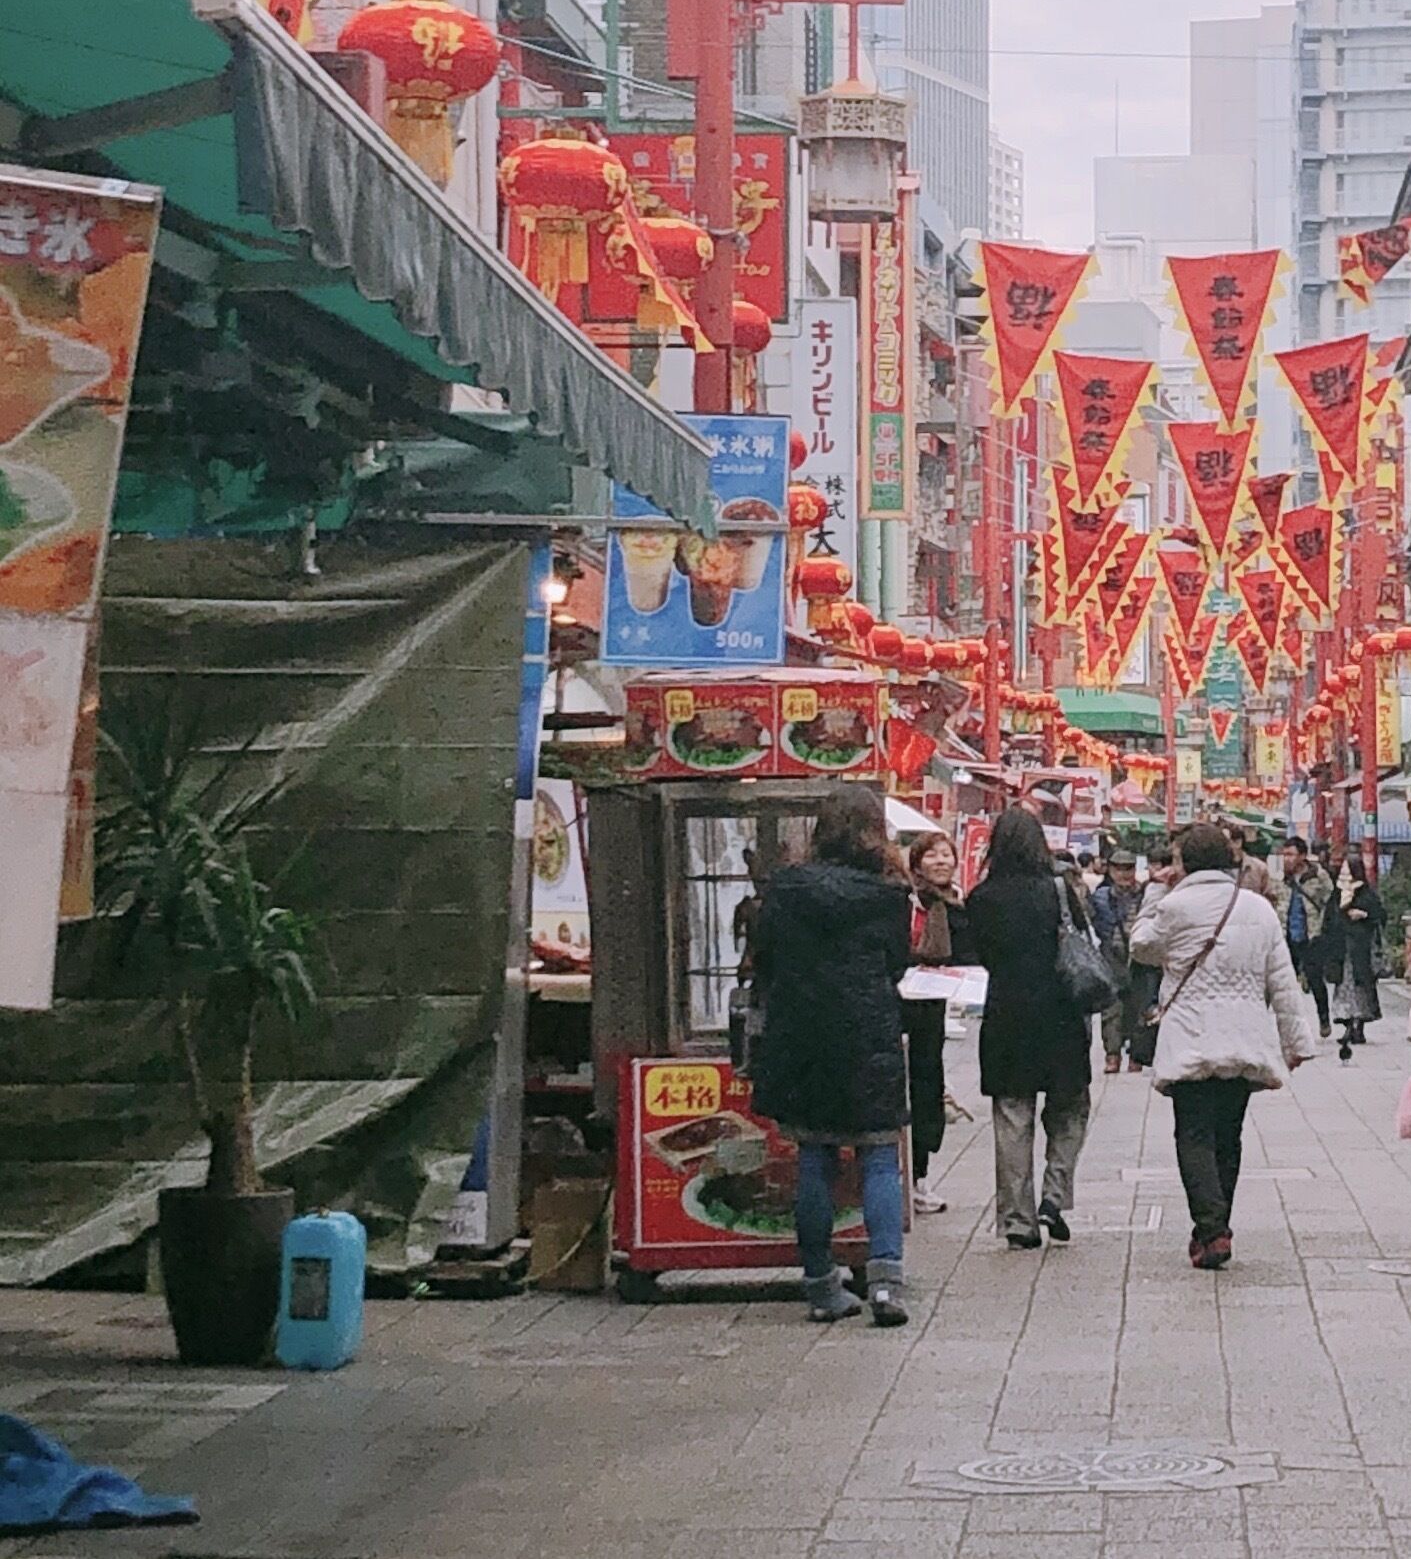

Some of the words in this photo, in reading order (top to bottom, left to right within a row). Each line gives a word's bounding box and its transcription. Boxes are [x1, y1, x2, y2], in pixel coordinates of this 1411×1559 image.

[809, 318, 837, 455] キリンビール
